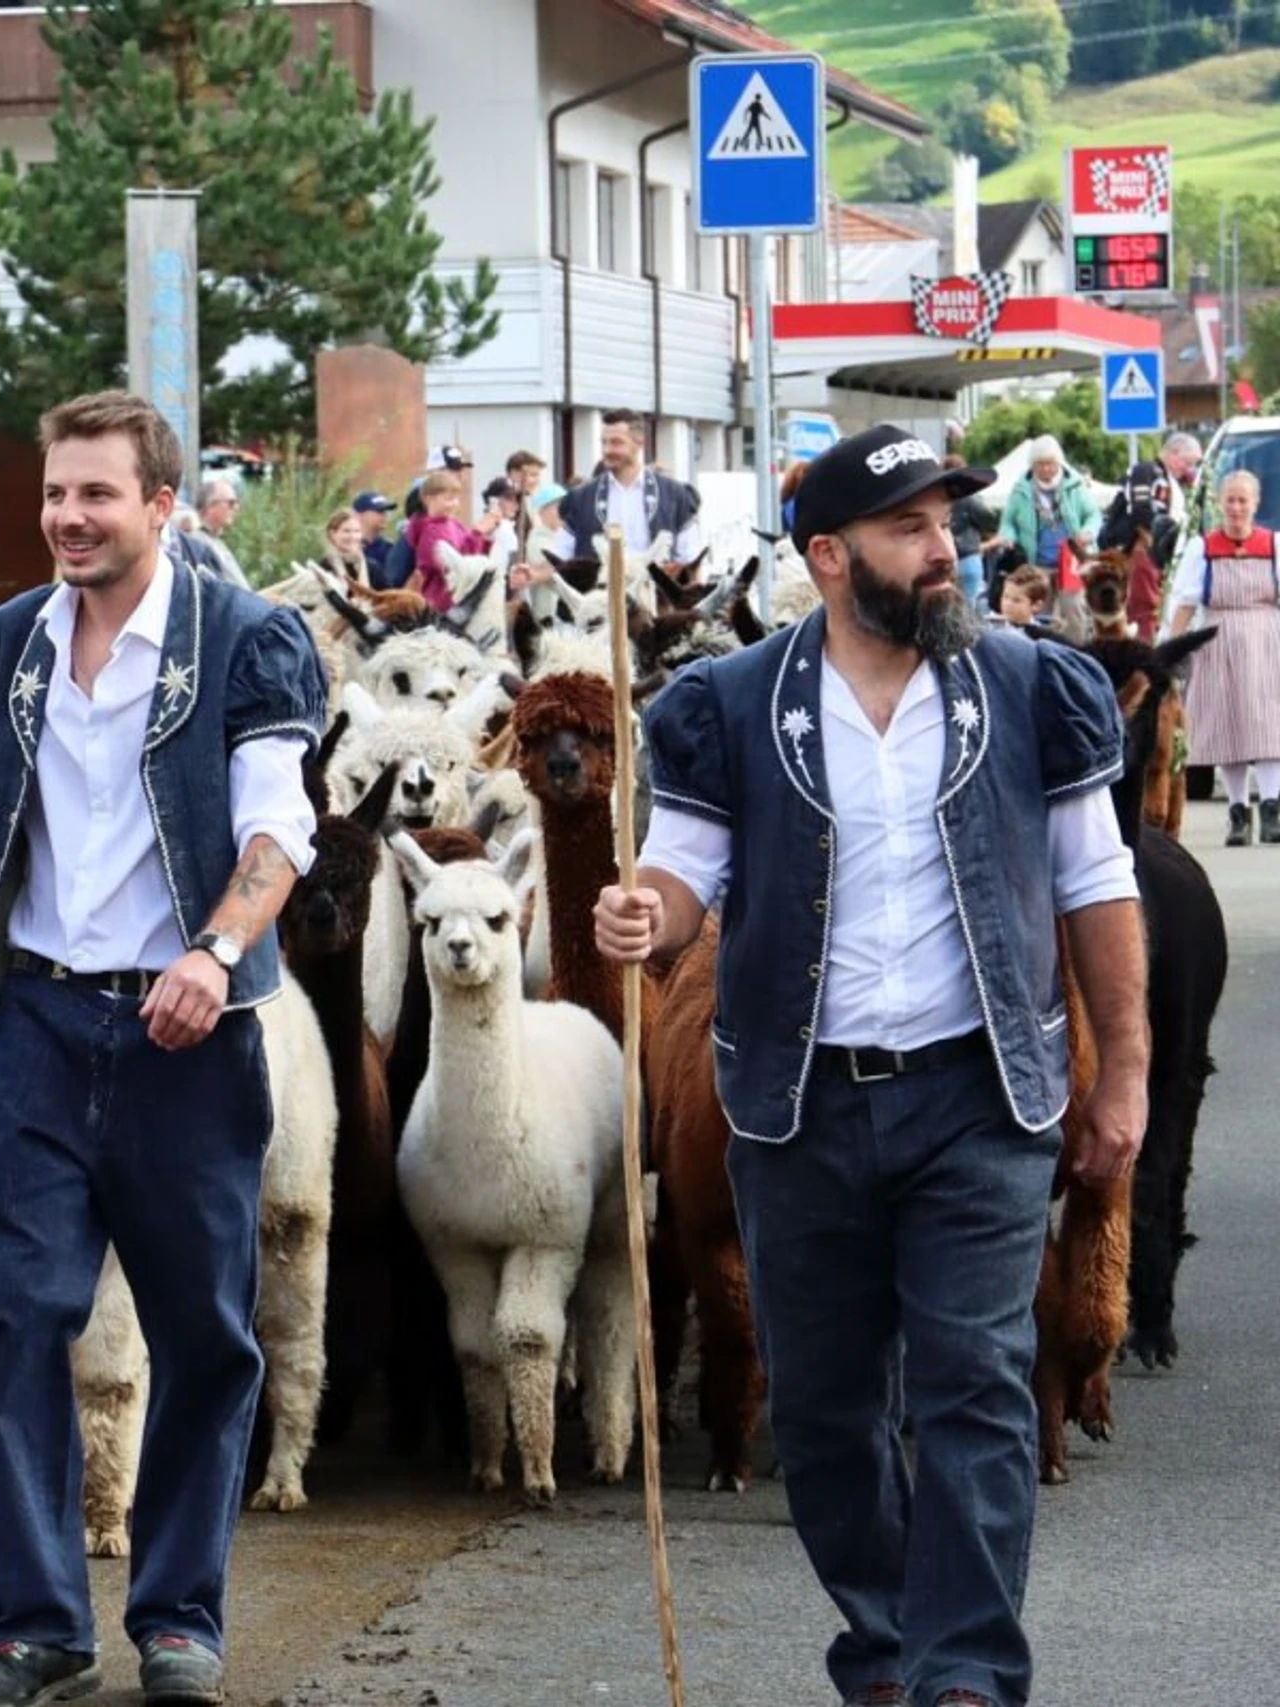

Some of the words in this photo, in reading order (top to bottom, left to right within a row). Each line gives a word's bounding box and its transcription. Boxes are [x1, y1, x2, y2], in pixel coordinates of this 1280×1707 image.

[1109, 171, 1148, 184] MINI
[1109, 186, 1148, 198] PRIX
[932, 291, 978, 306] MINI
[932, 308, 978, 323] PRIX
